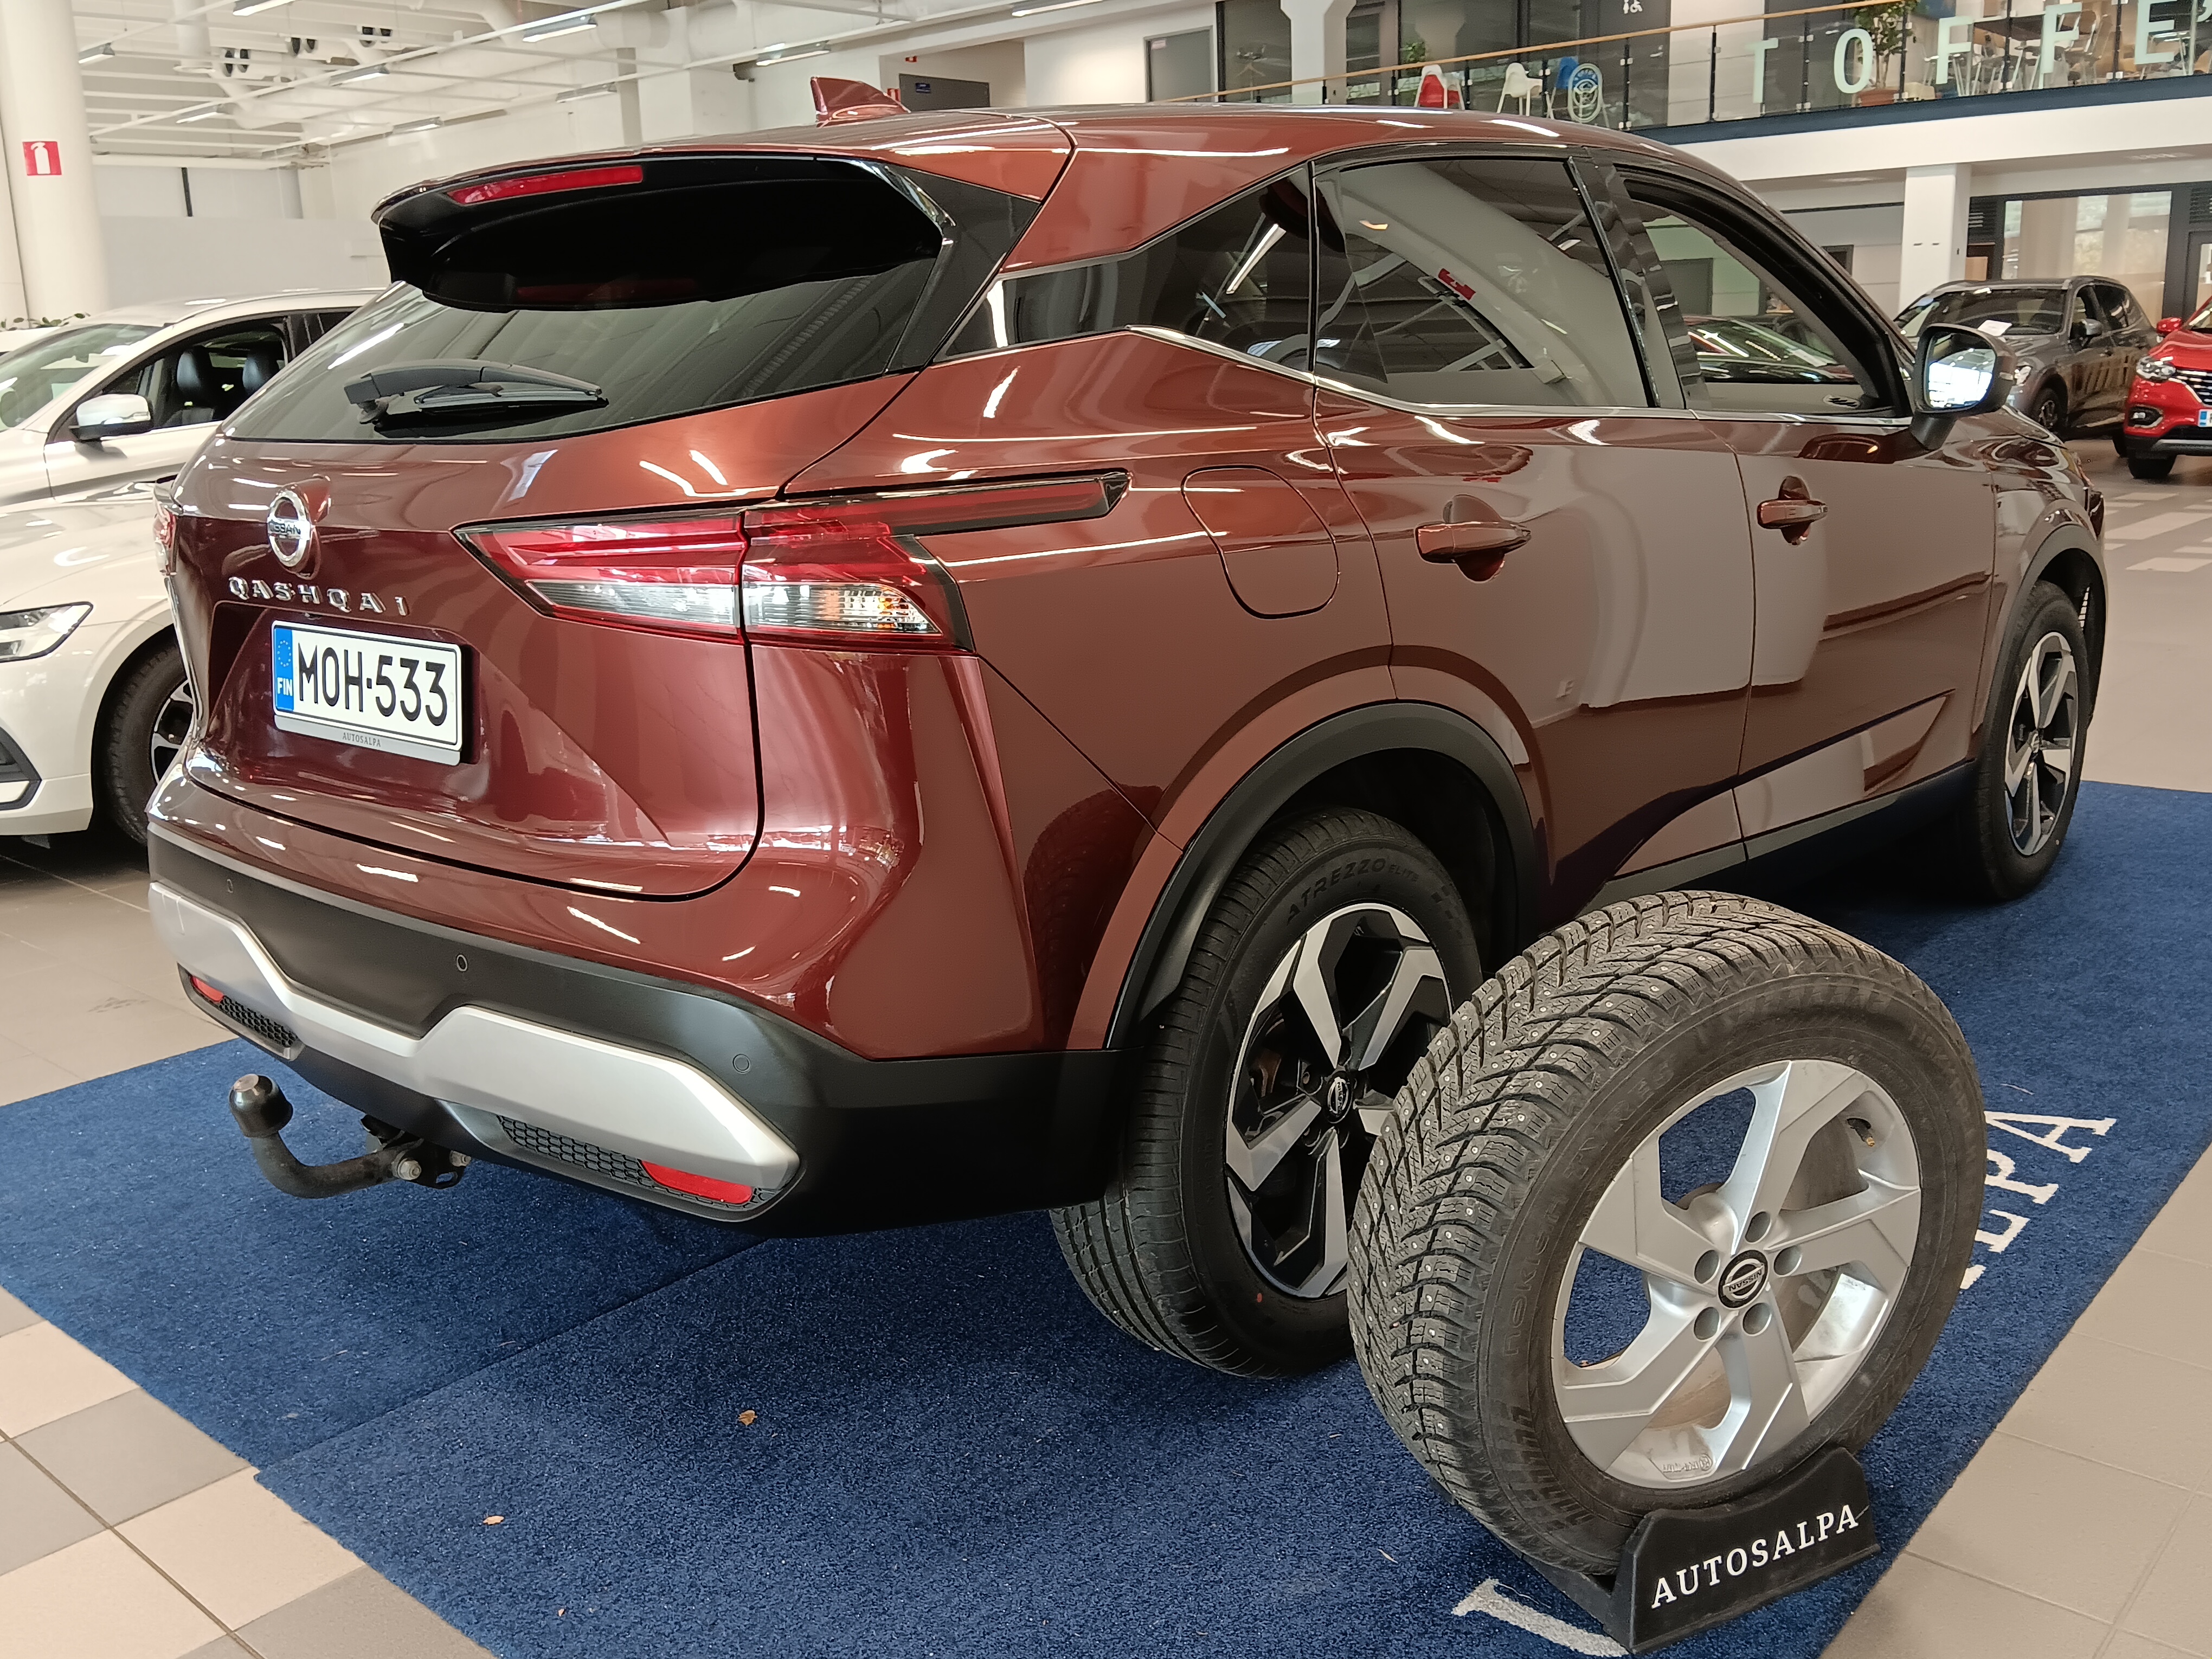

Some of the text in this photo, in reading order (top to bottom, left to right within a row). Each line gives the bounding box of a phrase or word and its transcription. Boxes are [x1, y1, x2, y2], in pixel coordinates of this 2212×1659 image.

[229, 576, 409, 616] QASHQAI
[277, 677, 293, 696] FIN
[298, 642, 448, 726] MOH-533
[342, 732, 381, 747] AUTOSALPA
[1287, 858, 1419, 926] ATREZZO ELITE
[1728, 1269, 1762, 1291] NISSAN
[1651, 1504, 1859, 1609] AUTOSALPA
